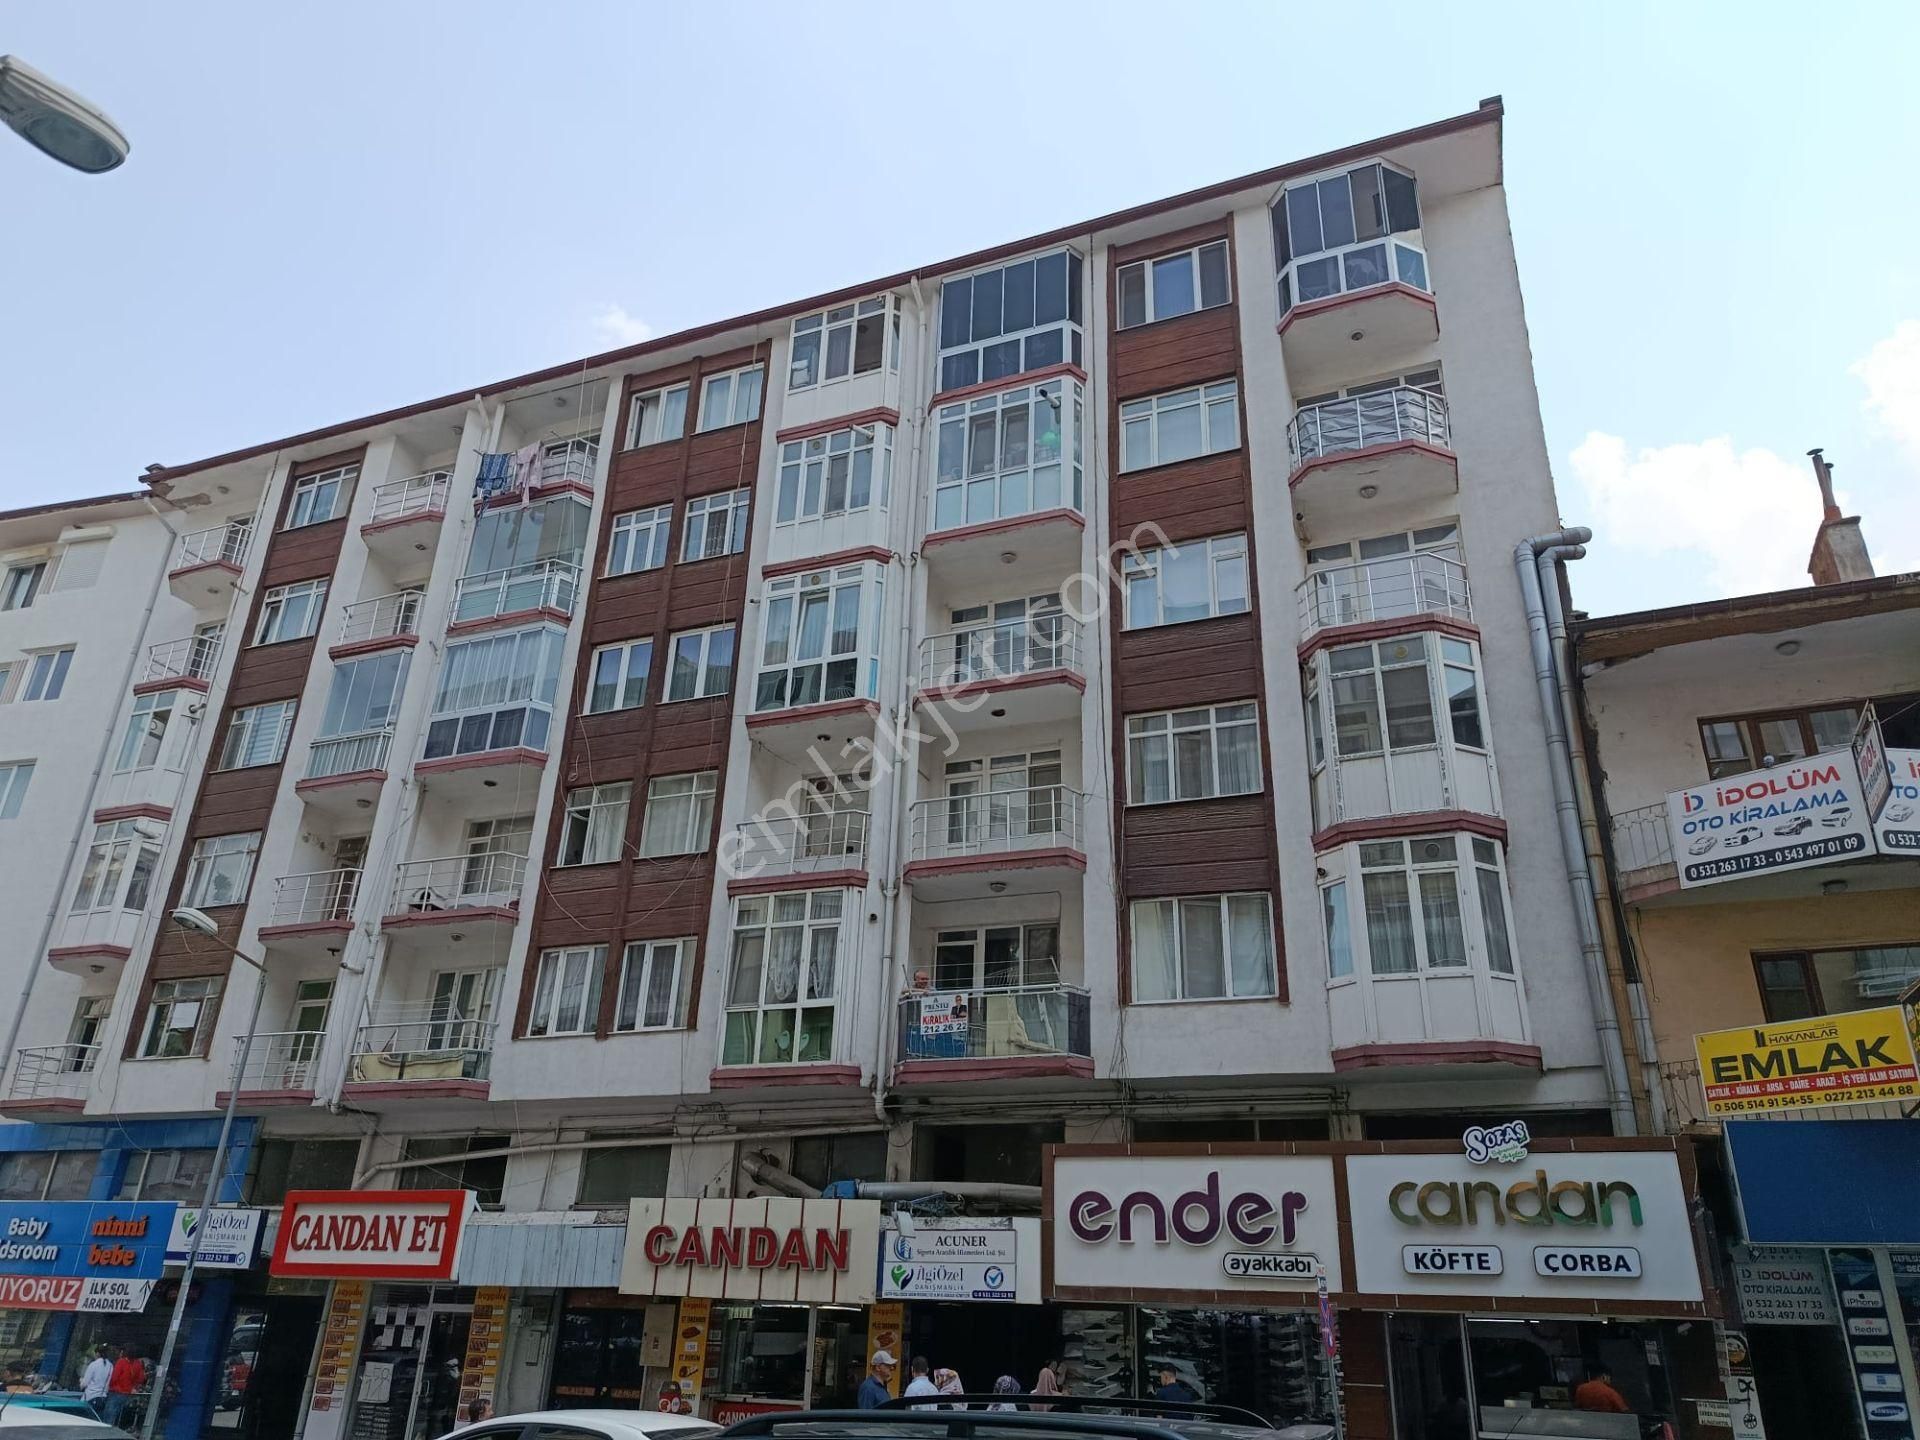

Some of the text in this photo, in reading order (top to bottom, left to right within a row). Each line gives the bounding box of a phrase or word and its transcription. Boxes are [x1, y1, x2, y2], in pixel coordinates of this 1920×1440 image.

[1716, 765, 1841, 807] İDOLÜM
[1893, 785, 1918, 799] TO
[1683, 815, 1723, 835] OTO
[1729, 789, 1848, 826] KİRALAMA
[1889, 835, 1915, 846] 0 532
[1690, 866, 1697, 878] 0
[1699, 862, 1718, 877] 532
[1720, 857, 1737, 872] 263
[1740, 854, 1750, 869] 17
[1754, 851, 1767, 866] 33
[1775, 850, 1782, 862] 0
[1783, 846, 1804, 861] 543
[1806, 841, 1825, 856] 497
[1828, 839, 1841, 853] 01
[1844, 836, 1858, 850] 09
[924, 1022, 967, 1034] 212 26 22
[1768, 1028, 1839, 1044] HAKANLAR
[1711, 1035, 1898, 1083] EMLAK
[1708, 1085, 1730, 1097] SATILIK
[1736, 1082, 1760, 1096] KİRALIK
[1766, 1081, 1784, 1092] ARSA
[1790, 1078, 1810, 1090] DAİRE
[1816, 1076, 1836, 1088] ARAZİ
[1843, 1072, 1851, 1086] İŞ
[1851, 1070, 1868, 1083] YERİ
[1869, 1069, 1888, 1081] ALIM
[1890, 1067, 1914, 1079] SATIMI
[1714, 1103, 1722, 1112] 0
[1724, 1100, 1744, 1111] 506
[1747, 1099, 1764, 1109] 514
[1768, 1097, 1779, 1107] 91
[1782, 1094, 1814, 1106] 54-55
[1824, 1090, 1853, 1102] 0272
[1856, 1088, 1875, 1099] 213
[1878, 1086, 1897, 1097] 44
[1899, 1085, 1914, 1095] 88
[1389, 1169, 1643, 1227] candan
[1069, 1170, 1309, 1247] ender
[7, 1216, 48, 1240] Baby
[92, 1214, 149, 1237] ninni
[206, 1210, 250, 1231] lgiÖzel
[203, 1232, 247, 1241] ANIŞMANLIK
[290, 1214, 449, 1252] CANDAN ET
[935, 1235, 987, 1247] ACUNER
[88, 1243, 136, 1266] bebe
[643, 1224, 852, 1272] CANDAN
[1230, 1256, 1312, 1275] ayakkabı
[1413, 1248, 1491, 1271] KÖFTE
[1544, 1253, 1632, 1273] ÇORBA
[1757, 1268, 1814, 1280] İDOLÜM
[0, 1278, 82, 1304] IYORUZ
[89, 1279, 130, 1295] İLK SOL
[914, 1283, 964, 1292] DANIŞMANLIK
[1743, 1283, 1821, 1295] OTO KİRALAMA
[81, 1297, 131, 1311] ARADAYIZ
[1746, 1299, 1823, 1309] 0 532 263 17 33
[1847, 1297, 1880, 1307] iPhone
[1749, 1310, 1825, 1320] 0 543 497 01 09
[1854, 1326, 1883, 1334] Redmi
